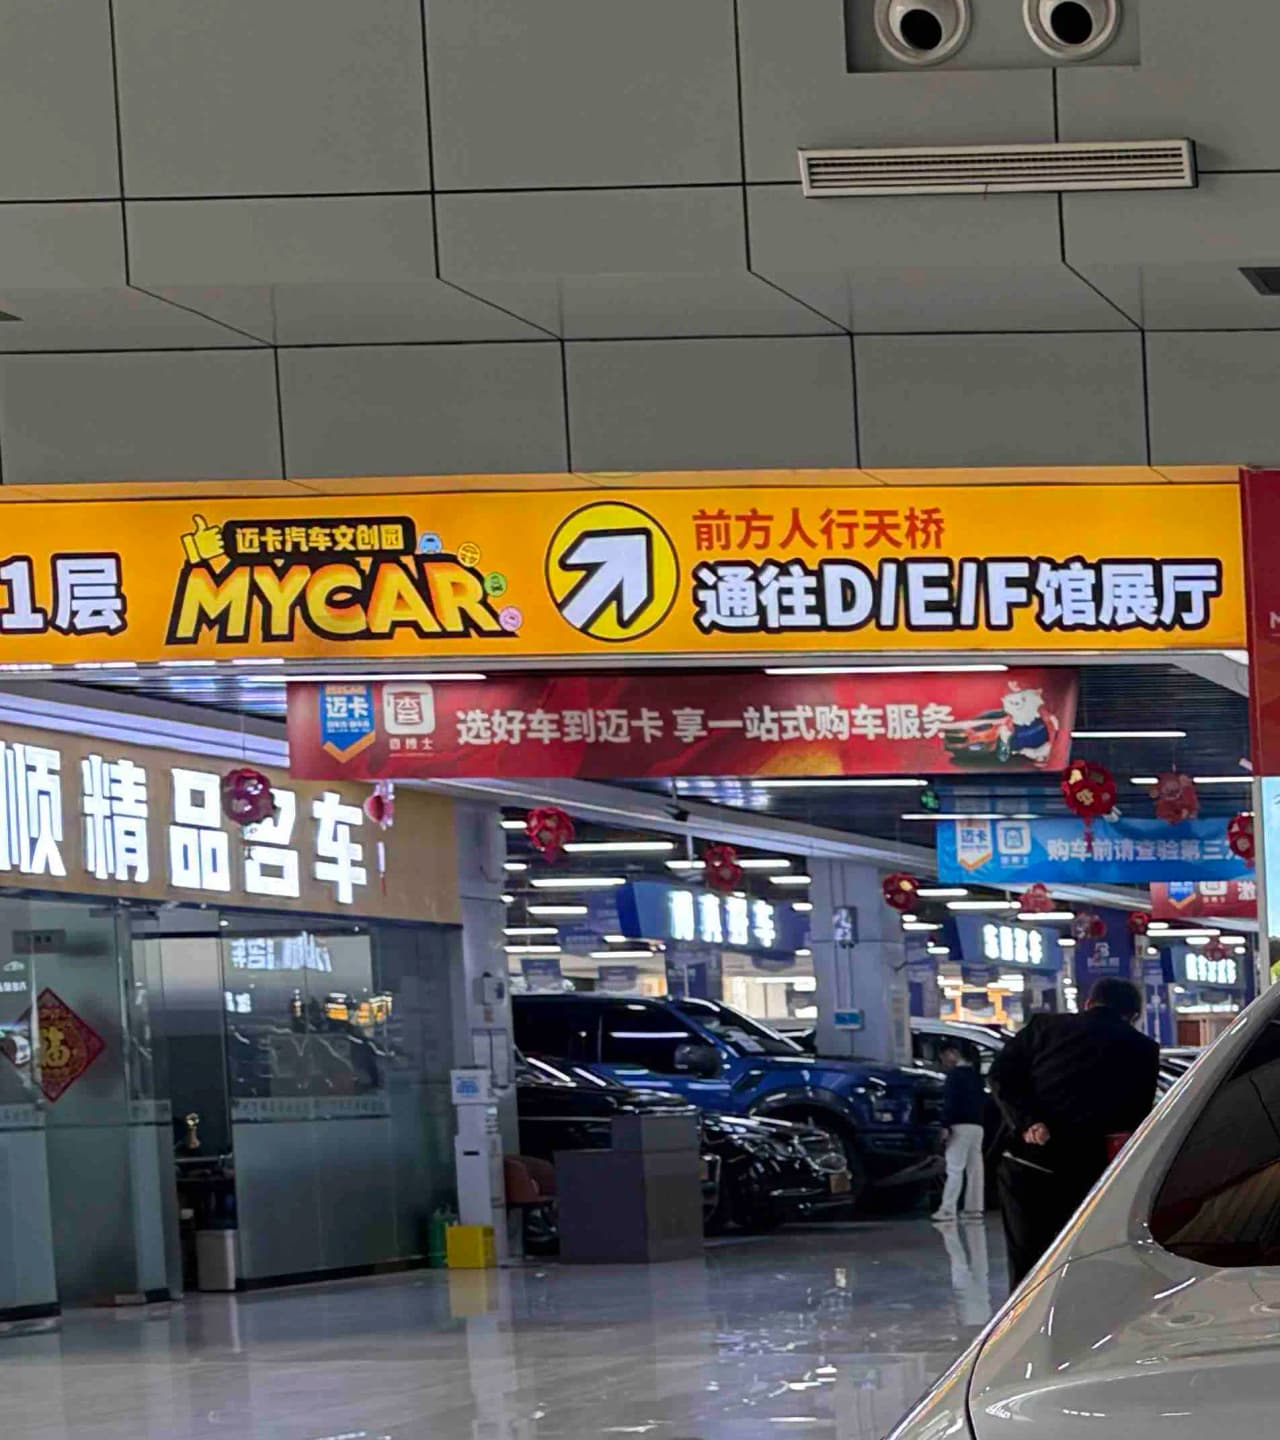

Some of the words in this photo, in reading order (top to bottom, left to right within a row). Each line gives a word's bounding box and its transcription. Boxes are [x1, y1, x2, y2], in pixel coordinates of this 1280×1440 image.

[235, 524, 405, 554] 迈卡汽车文创园
[693, 506, 945, 552] 前方人行天桥
[0, 554, 126, 635] 1层
[168, 557, 514, 645] MYCAR
[696, 557, 1220, 631] 通往D/E/F馆展厅
[325, 696, 369, 719] 迈卡
[456, 707, 663, 746] 选好车到迈卡
[673, 702, 957, 743] 享一站式购车服务
